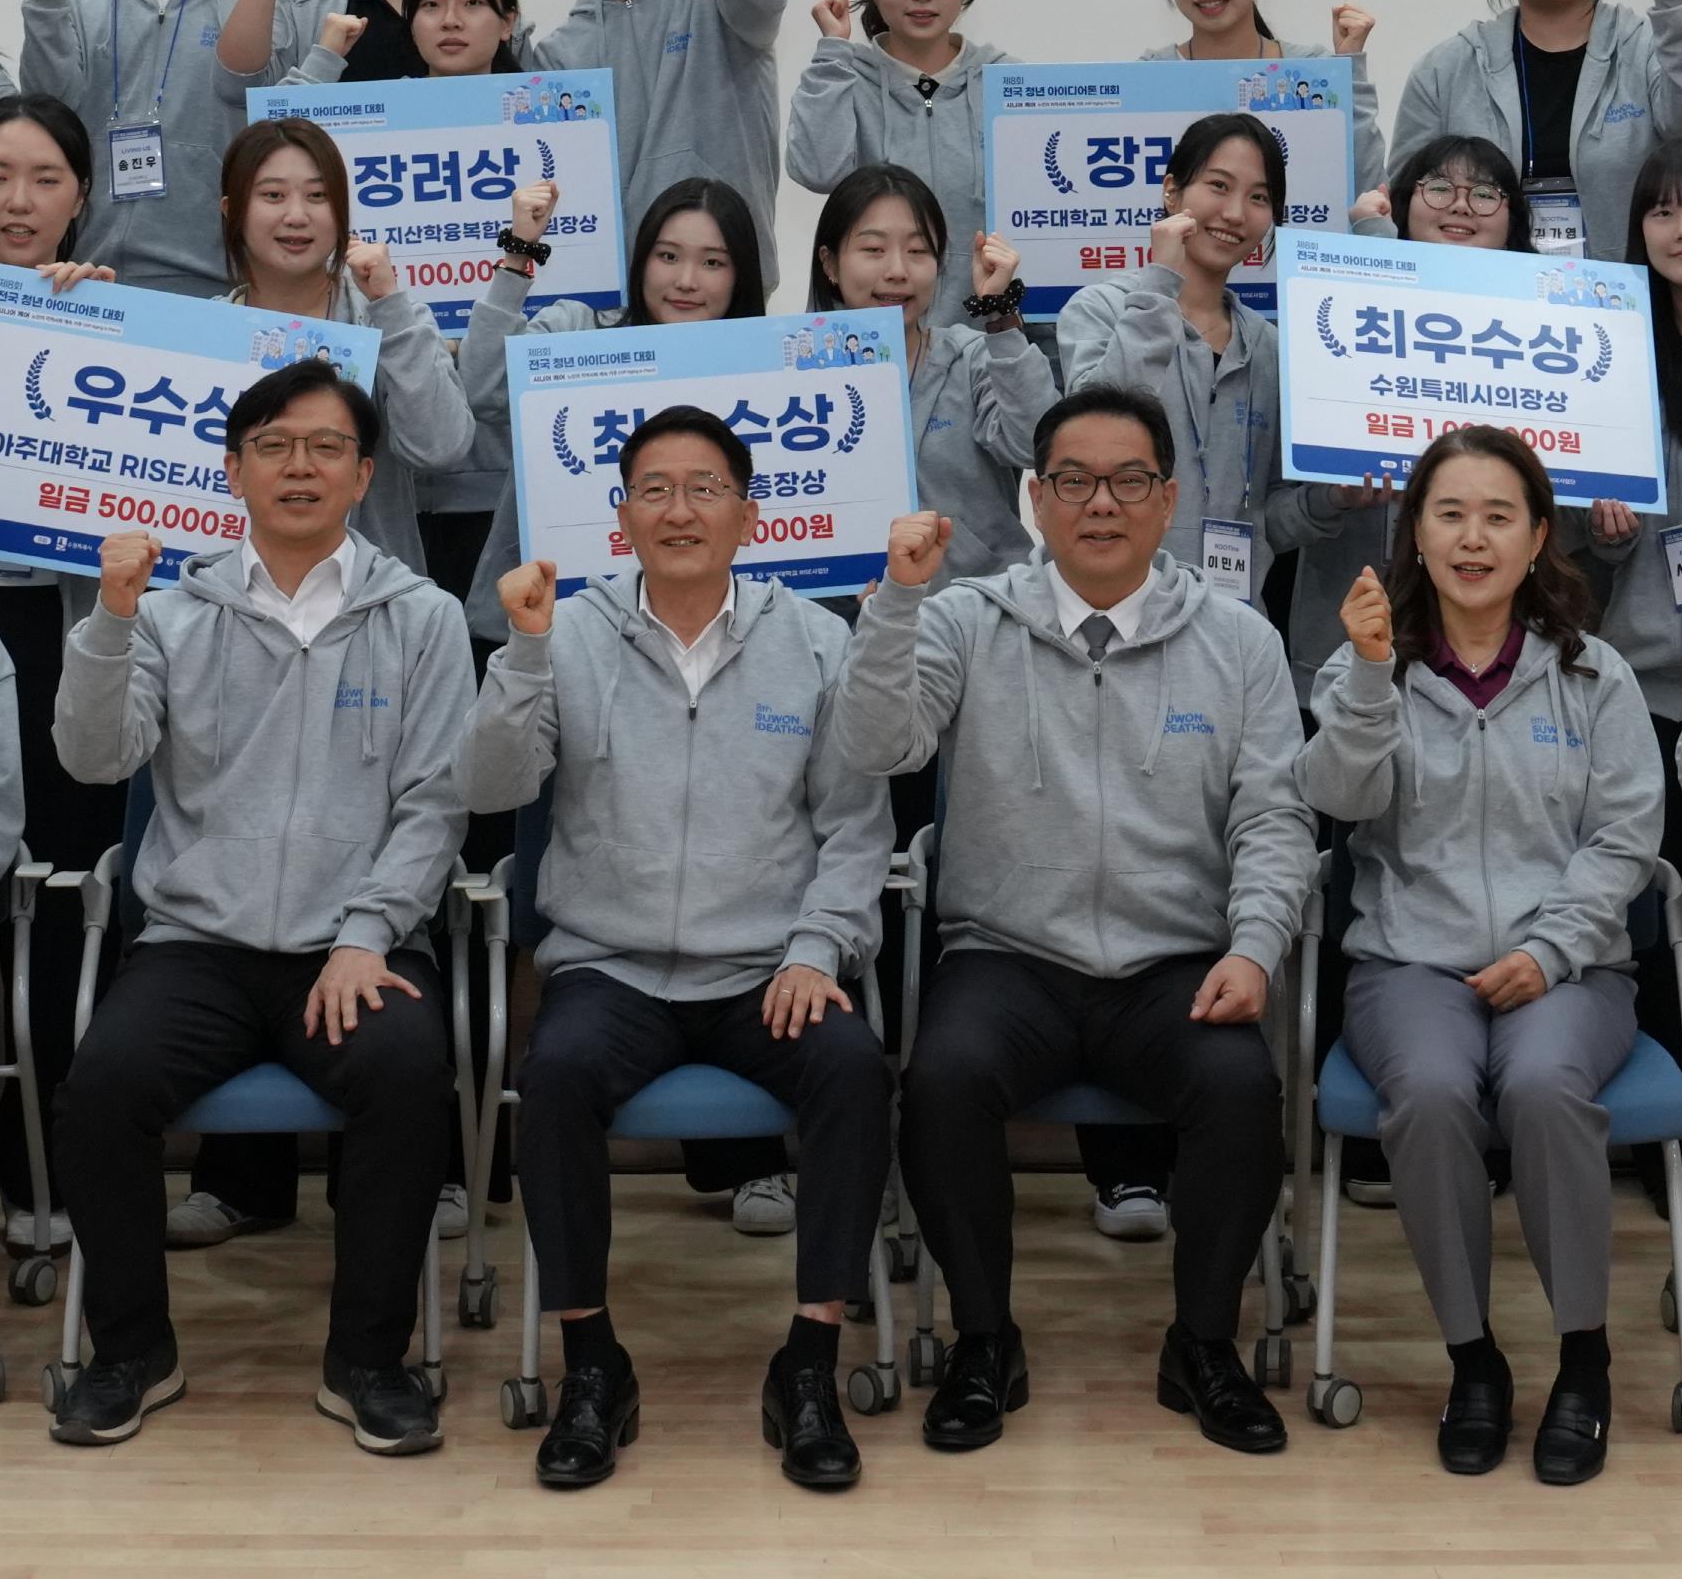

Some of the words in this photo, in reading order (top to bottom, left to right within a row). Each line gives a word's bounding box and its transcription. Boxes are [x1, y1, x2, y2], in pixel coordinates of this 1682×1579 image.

[1003, 87, 1022, 97] 전국
[1025, 86, 1045, 97] 청년
[1048, 85, 1097, 96] 아이디어톤
[1100, 84, 1120, 95] 대회
[268, 109, 287, 119] 전국
[290, 108, 310, 118] 청년
[313, 104, 362, 117] 아이디어톤
[365, 103, 385, 114] 대회
[354, 147, 520, 208] 장려상
[385, 214, 598, 245] 지산학융복합원장상
[1011, 207, 1108, 229] 아주대학교
[1079, 246, 1127, 269] 일금
[1297, 250, 1317, 261] 전국
[1320, 253, 1340, 264] 청년
[1343, 255, 1393, 269] 아이디어톤
[1396, 260, 1416, 272] 대회
[21, 294, 43, 308] 청년
[45, 298, 100, 318] 아이디어톤
[102, 308, 125, 322] 대회
[1355, 306, 1582, 376] 최우수상
[529, 359, 550, 371] 전국
[553, 357, 574, 369] 청년
[578, 352, 631, 367] 아이디어톤
[634, 350, 655, 362] 대회
[1369, 374, 1569, 414] 수원특례시의장상
[593, 393, 834, 466] 최수상
[1365, 412, 1415, 440] 일금
[120, 454, 230, 495] RISE사업
[38, 482, 91, 515] 일금
[98, 492, 246, 540] 500,000원
[755, 712, 800, 725] SUWON
[755, 721, 812, 737] IDEATHON
[1163, 723, 1215, 734] DEATHON
[1166, 712, 1203, 724] UWON
